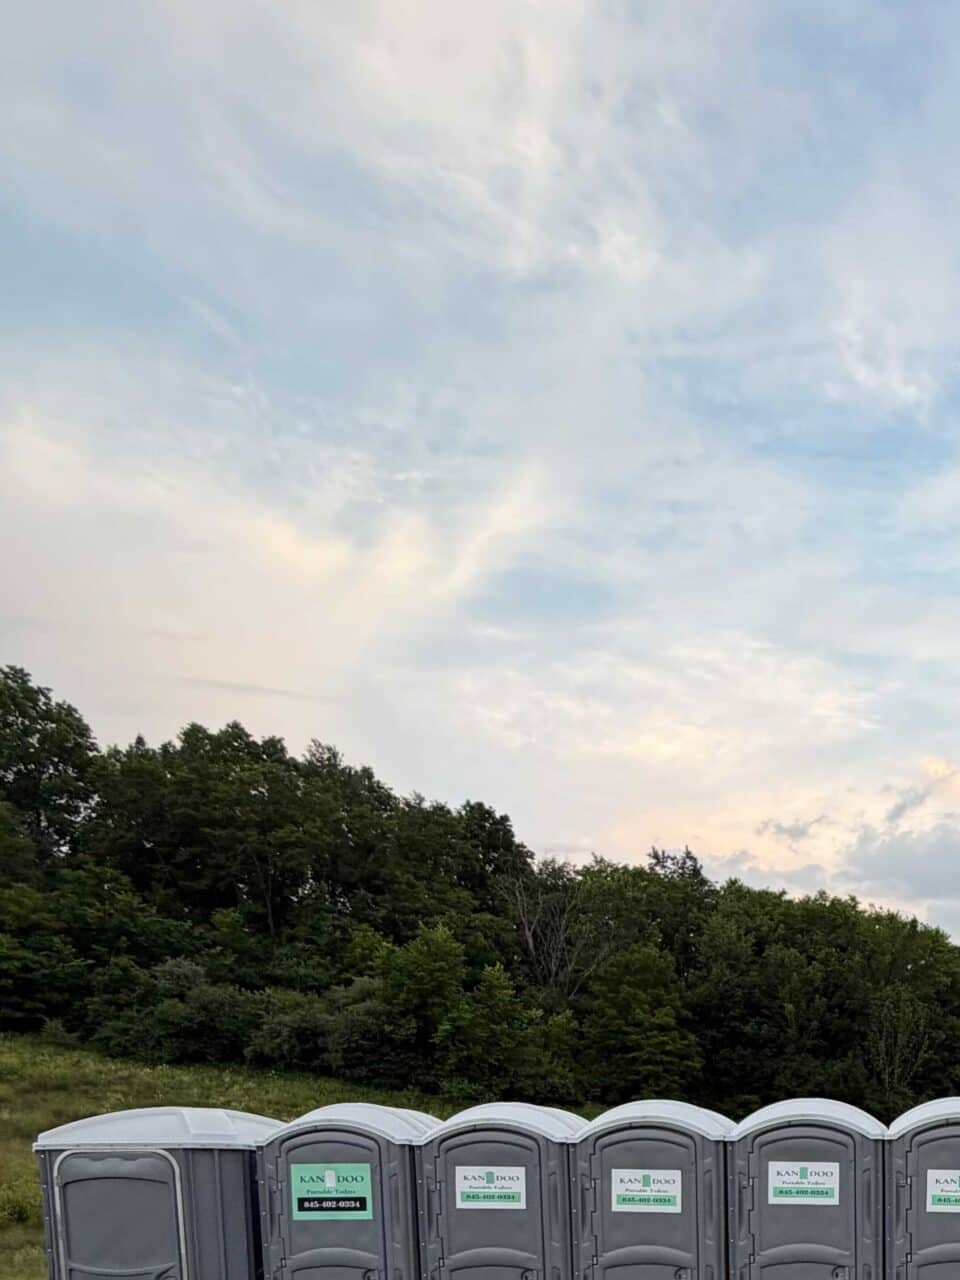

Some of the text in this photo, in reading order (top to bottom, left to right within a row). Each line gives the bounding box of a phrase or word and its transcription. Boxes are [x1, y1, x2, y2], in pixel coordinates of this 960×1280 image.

[299, 1175, 364, 1184] KAN DOO
[303, 1200, 361, 1208] 845-402-0334
